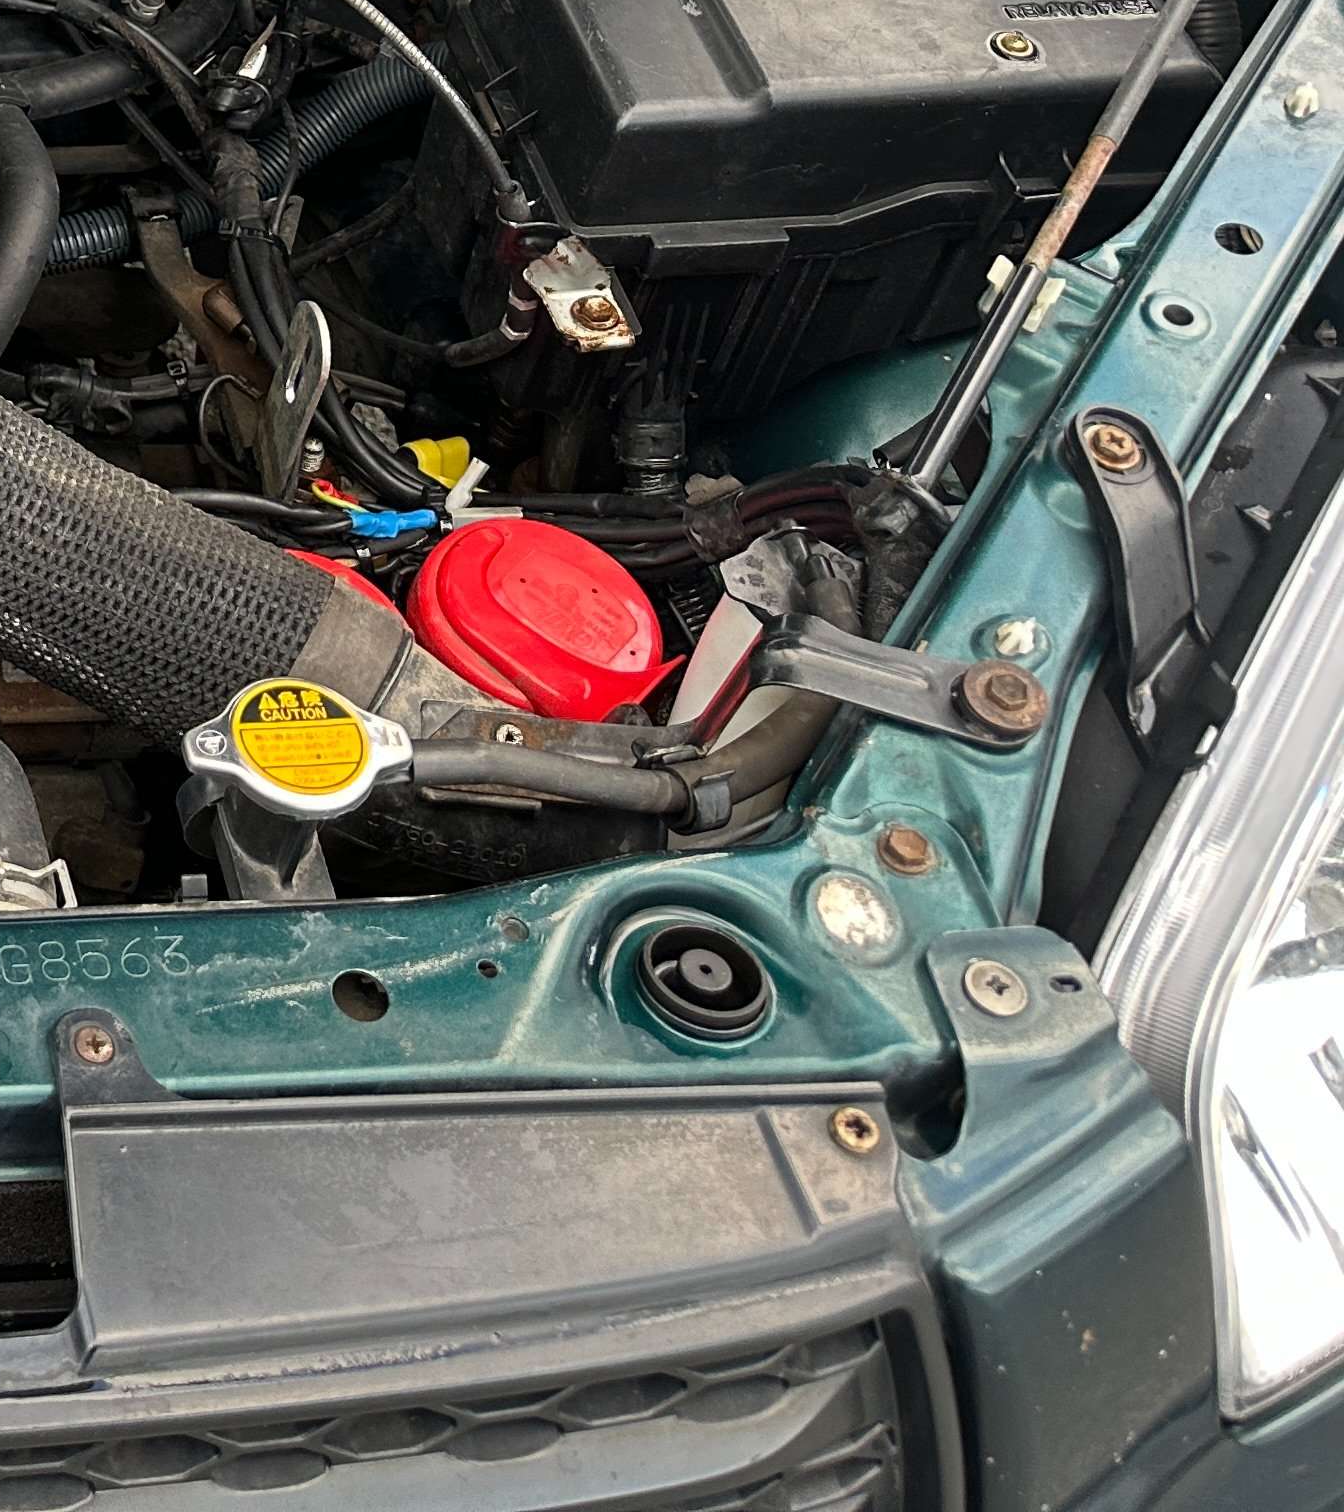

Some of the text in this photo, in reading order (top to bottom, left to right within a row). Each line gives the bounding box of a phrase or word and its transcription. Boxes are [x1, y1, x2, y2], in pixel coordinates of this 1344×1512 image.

[1002, 1, 1073, 21] RELAY
[278, 690, 323, 709] 危険
[260, 706, 328, 722] CAUTION
